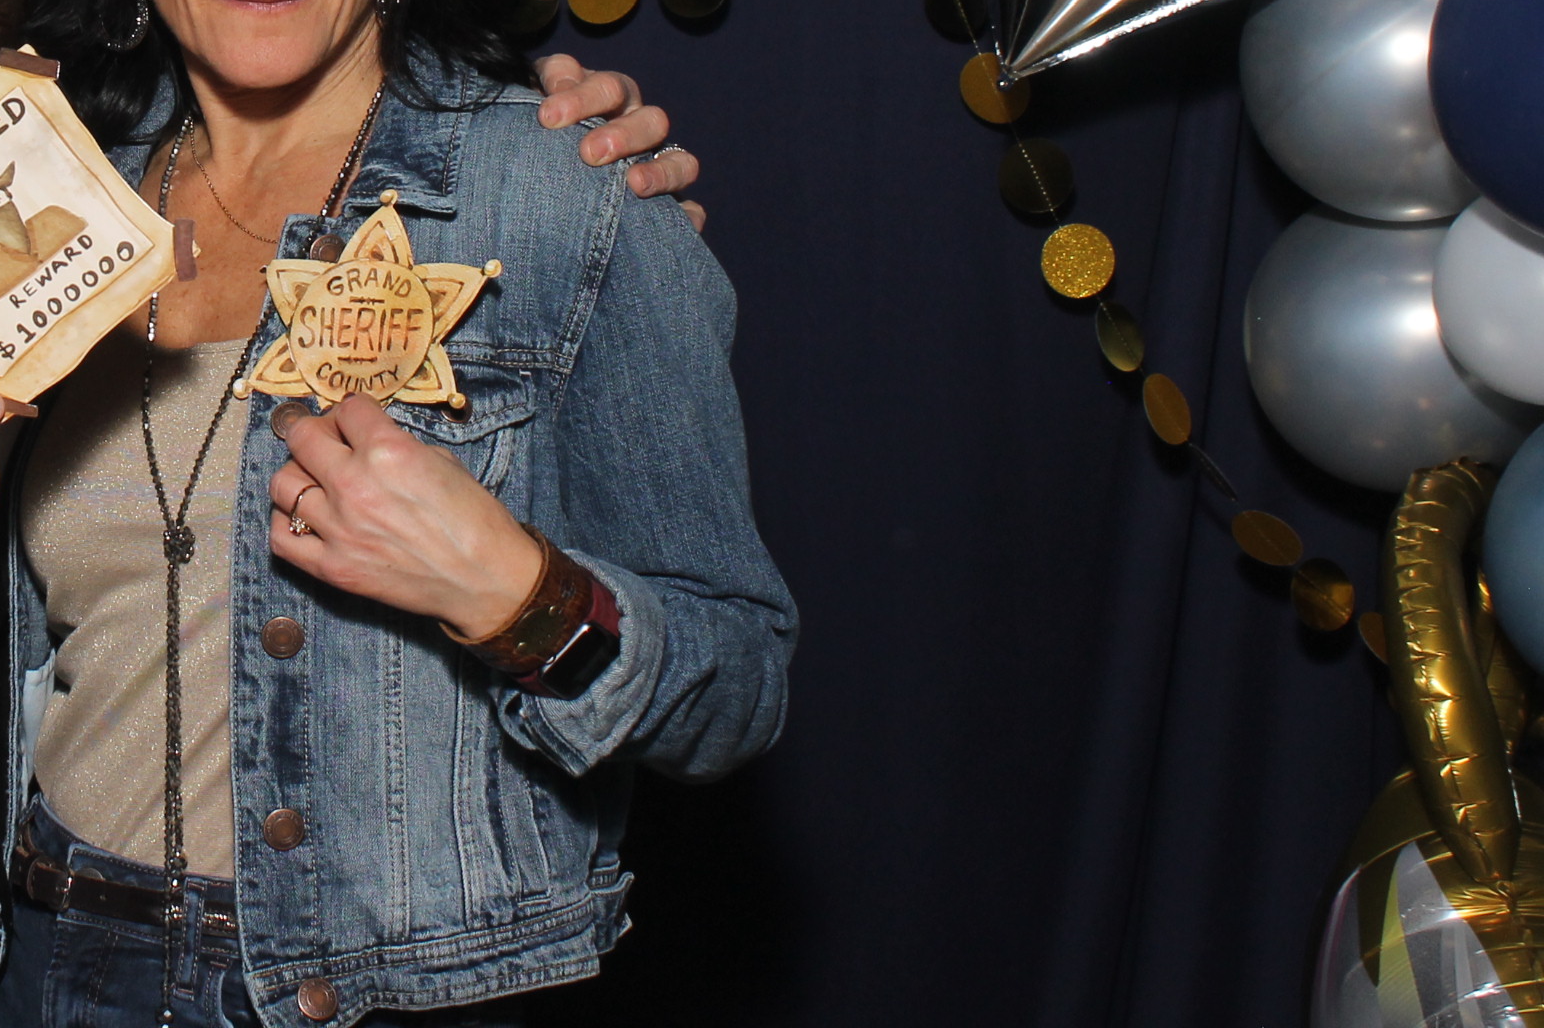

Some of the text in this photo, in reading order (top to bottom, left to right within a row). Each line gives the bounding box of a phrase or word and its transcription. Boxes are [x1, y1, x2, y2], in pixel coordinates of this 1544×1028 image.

[8, 234, 93, 309] REWARD
[327, 268, 411, 298] GRAND
[297, 305, 423, 352] SHERIFF
[316, 362, 400, 392] COUNTY
